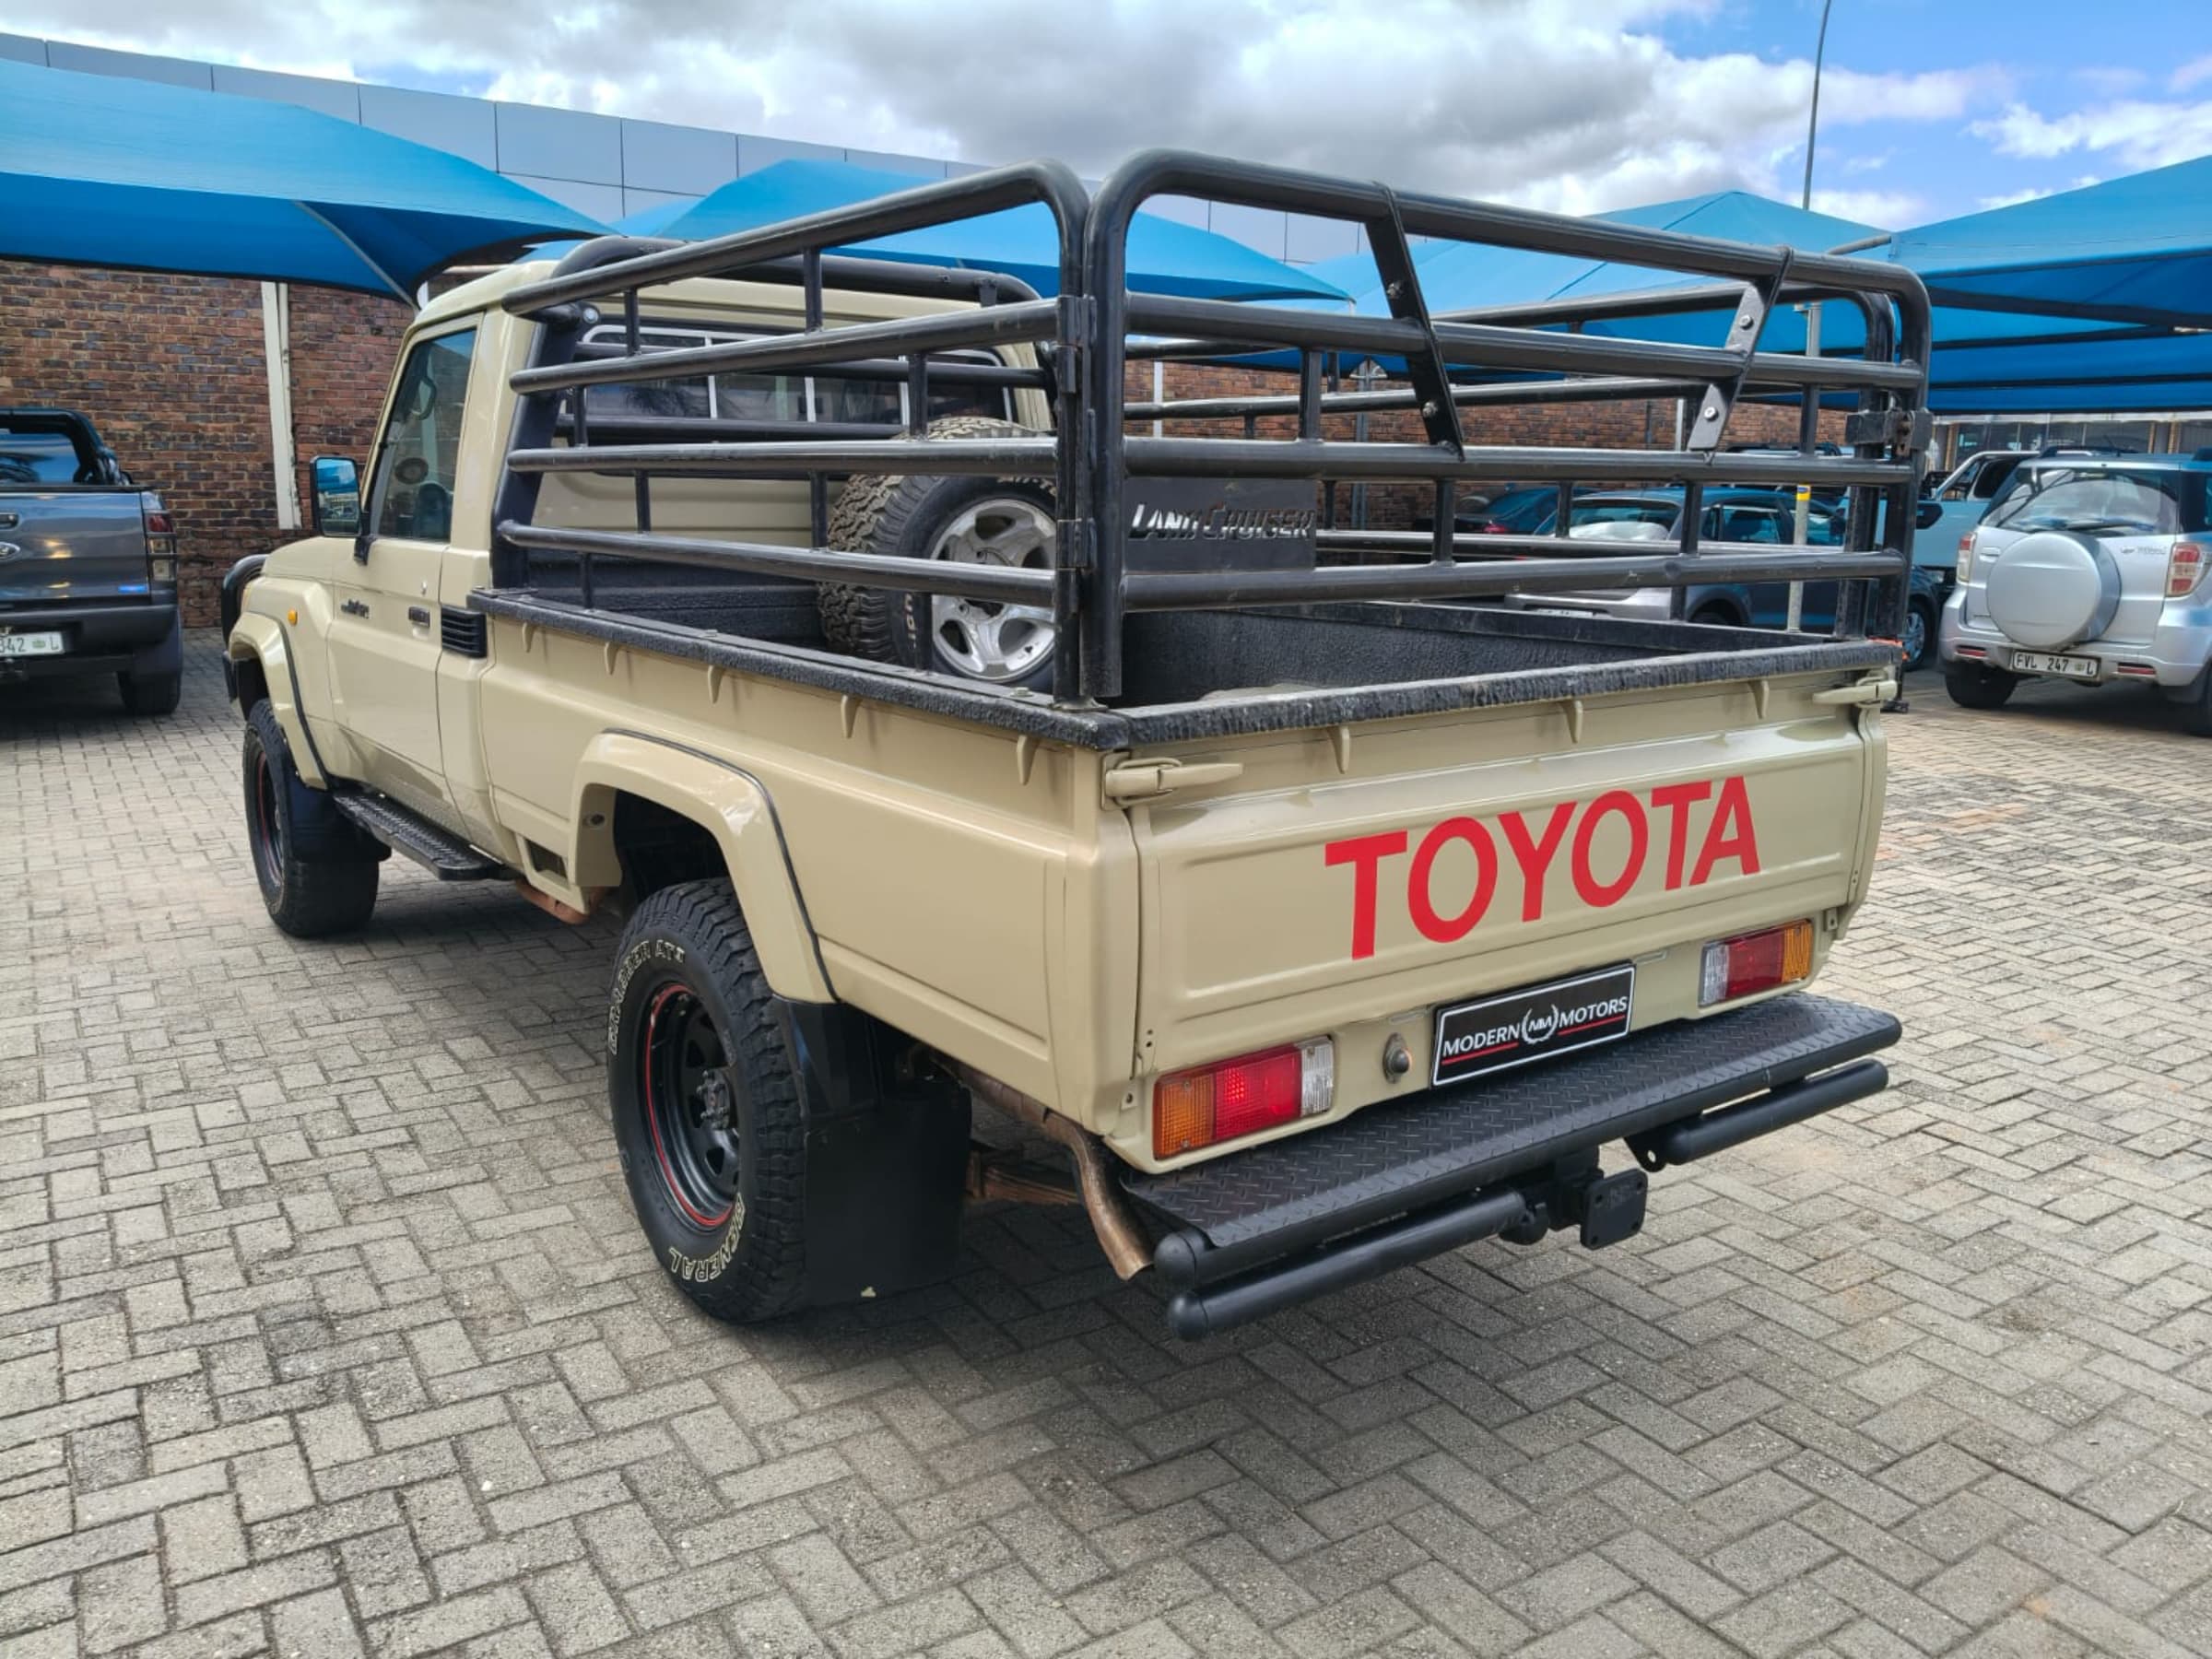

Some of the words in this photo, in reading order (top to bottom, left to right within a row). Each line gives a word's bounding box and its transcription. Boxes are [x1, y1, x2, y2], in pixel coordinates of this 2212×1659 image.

[49, 634, 60, 651] L
[2016, 653, 2037, 669] FVL
[2047, 656, 2070, 673] 247
[2086, 661, 2094, 676] L
[1324, 775, 1760, 960] TOYOTA
[1441, 1022, 1520, 1057] MODERN
[1558, 995, 1629, 1028] MOTORS
